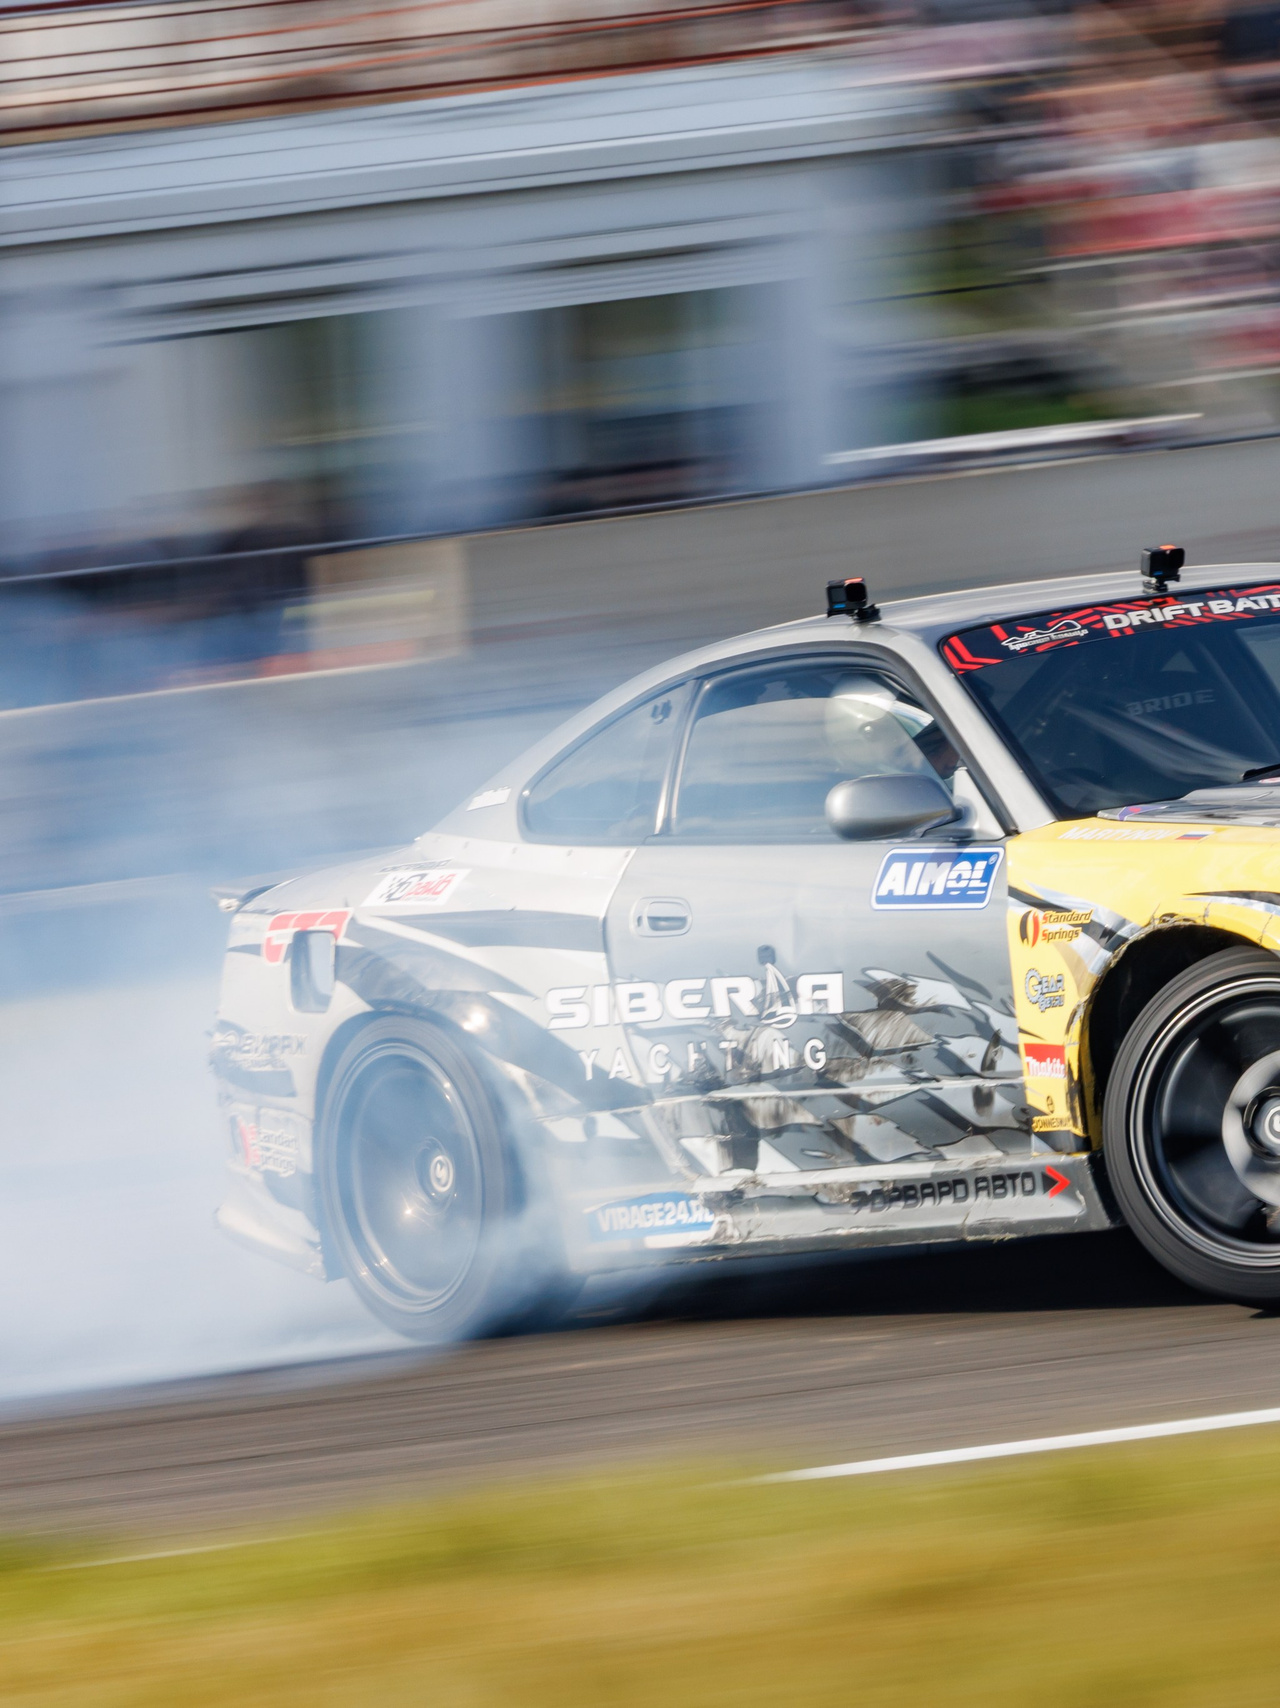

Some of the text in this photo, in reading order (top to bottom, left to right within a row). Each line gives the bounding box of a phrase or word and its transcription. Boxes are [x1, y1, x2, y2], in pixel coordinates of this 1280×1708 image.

[1103, 602, 1204, 630] DRIFT
[1126, 689, 1216, 717] BRIDE
[1057, 826, 1181, 841] MARTYNOV
[1042, 910, 1093, 924] Standard
[1041, 928, 1080, 943] Springs
[975, 1171, 1036, 1201] АВТО
